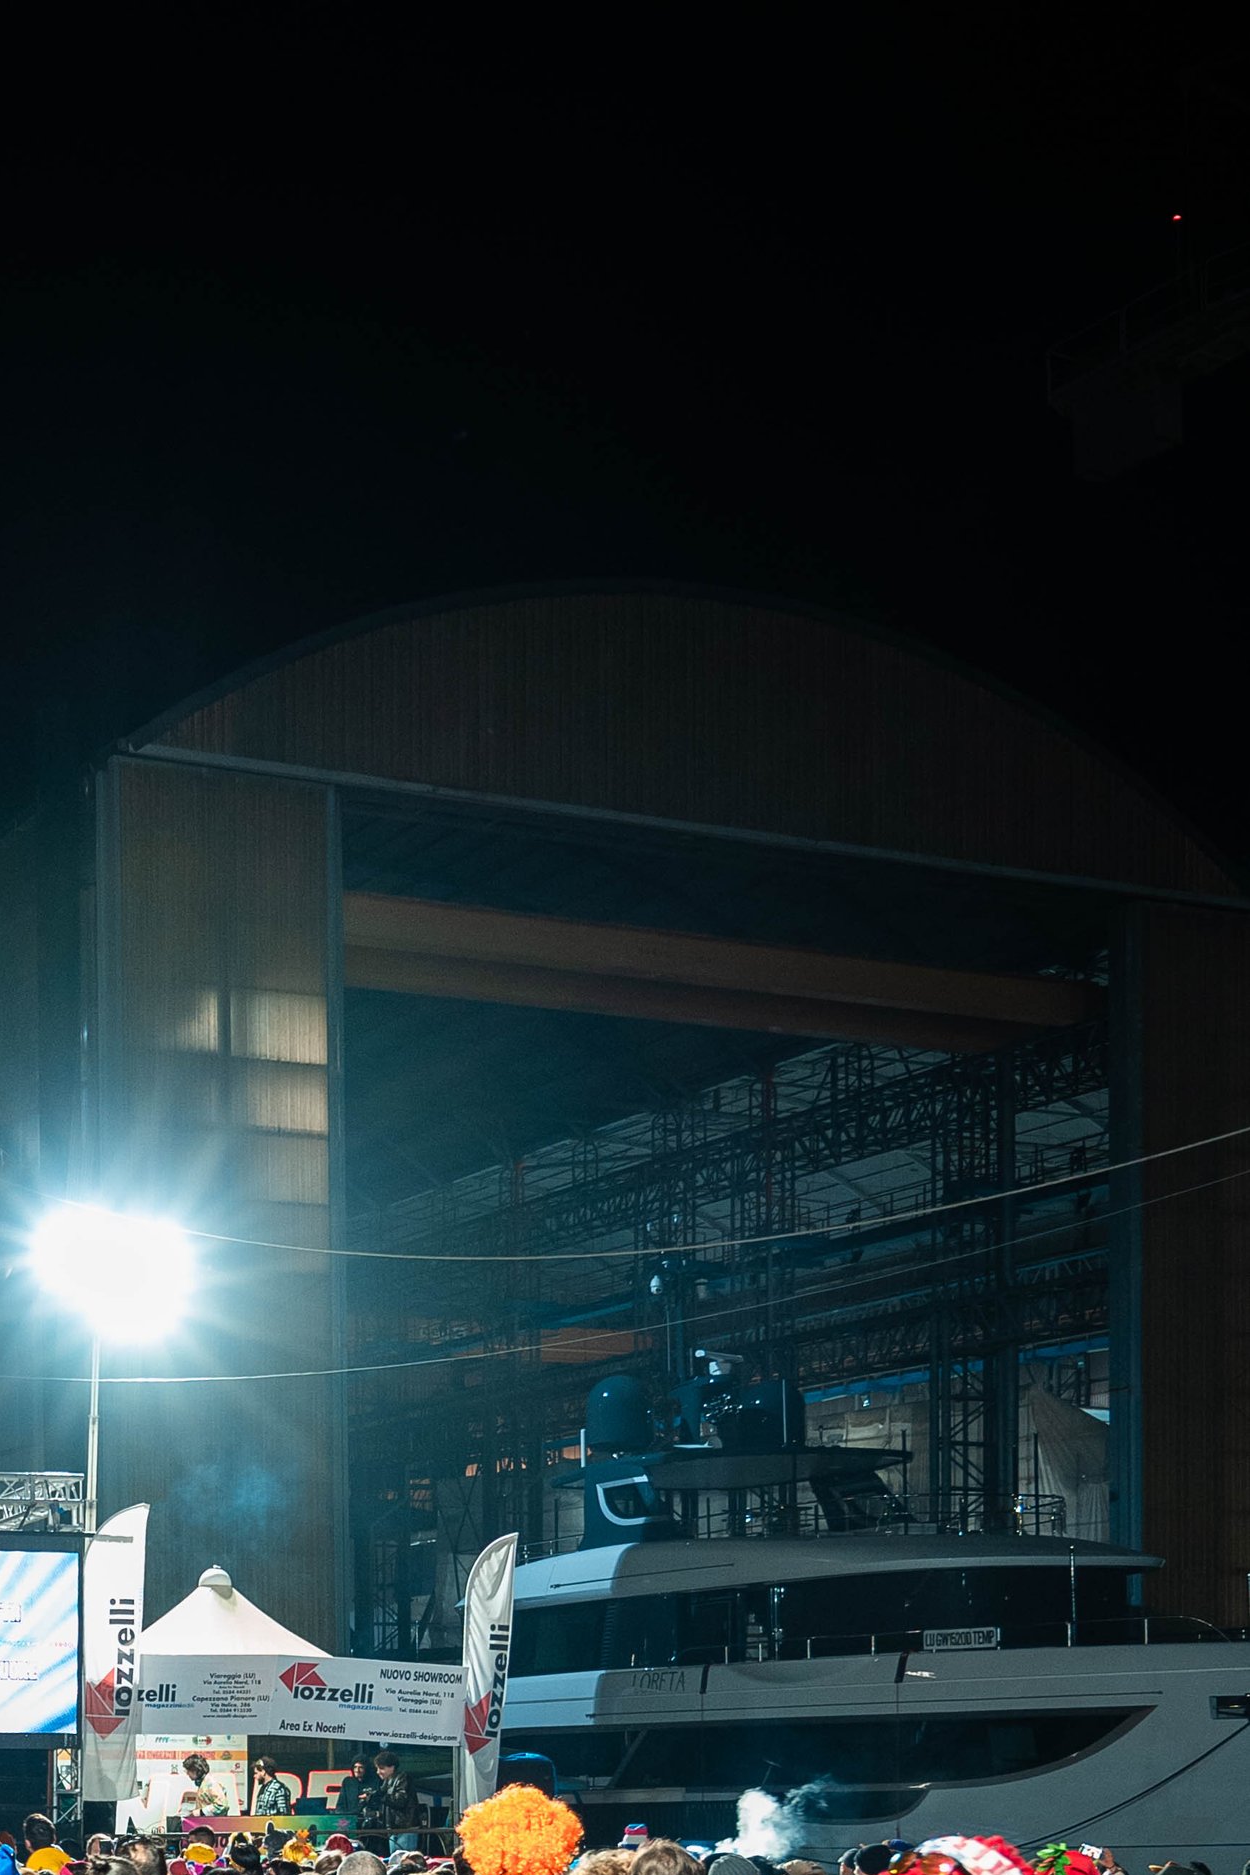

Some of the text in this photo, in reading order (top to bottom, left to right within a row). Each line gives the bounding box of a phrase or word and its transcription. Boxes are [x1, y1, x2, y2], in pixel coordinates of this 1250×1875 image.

[973, 1630, 994, 1645] TEMP
[380, 1669, 462, 1685] NUOVO SHOWROOM
[397, 1696, 428, 1705] Viareggio
[279, 1720, 346, 1733] Area Ex Nocetti
[368, 1729, 457, 1742] www.iozzelli-design.com
